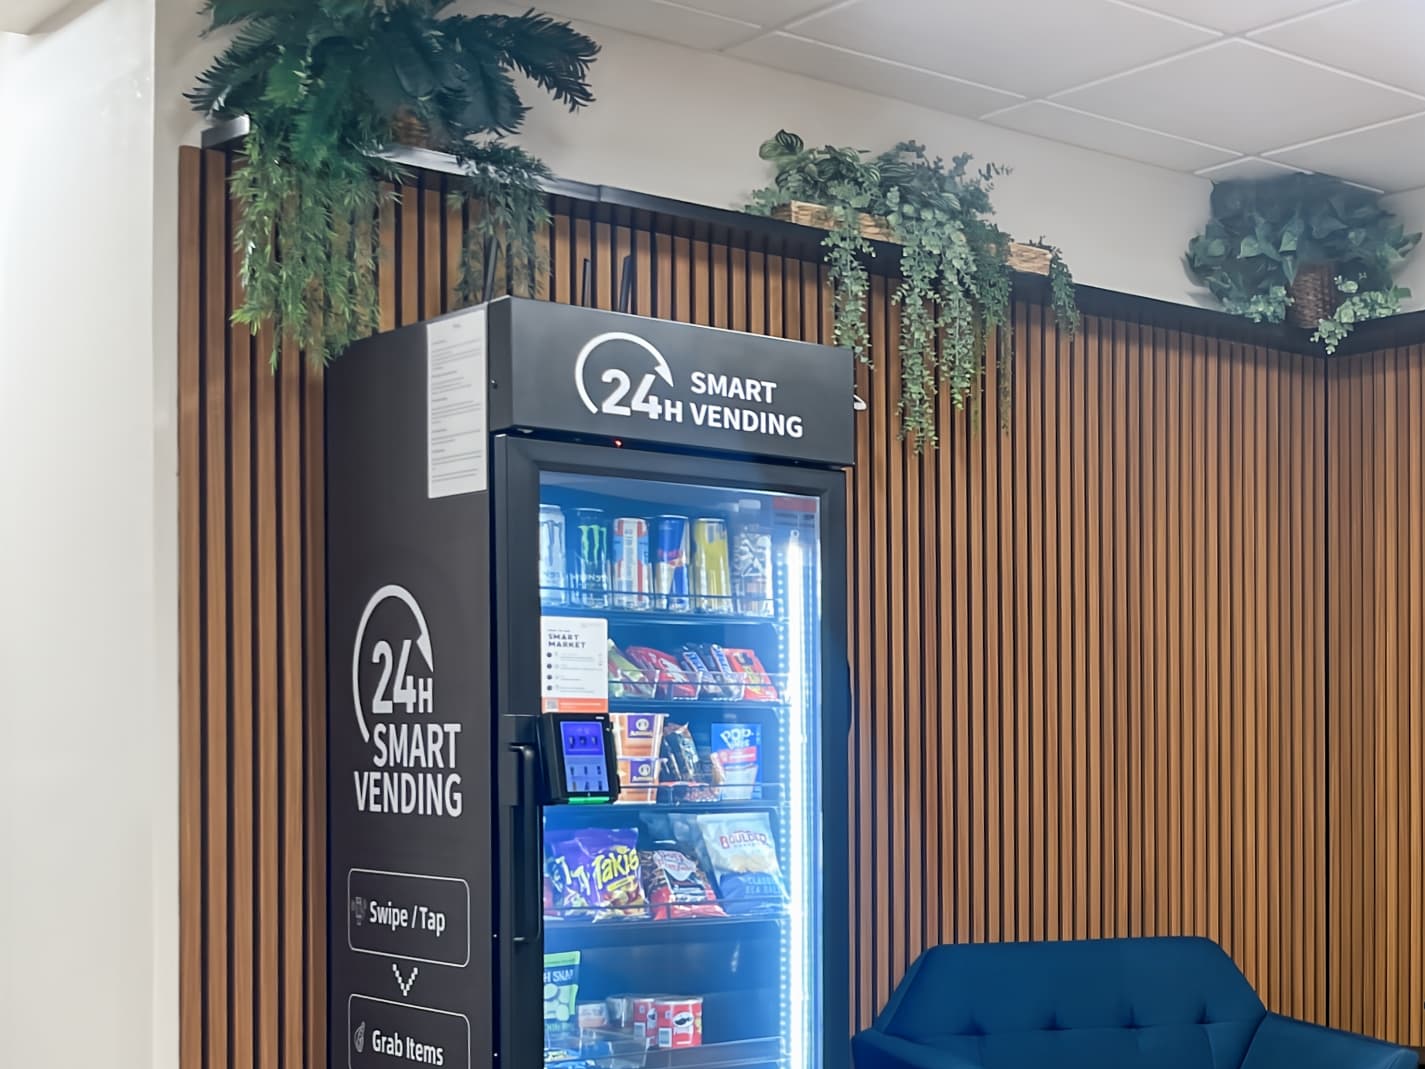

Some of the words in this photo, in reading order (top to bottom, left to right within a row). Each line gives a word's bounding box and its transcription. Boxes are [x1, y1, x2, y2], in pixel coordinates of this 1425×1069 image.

[601, 369, 684, 424] 24H
[690, 370, 777, 403] SMART
[689, 402, 804, 438] VENDING
[548, 633, 579, 641] SMART
[372, 640, 434, 714] 24H
[373, 723, 462, 769] SMART
[354, 771, 462, 818] VENDING
[592, 850, 639, 889] Takis
[370, 900, 409, 931] Swipe
[418, 906, 446, 937] Tap
[372, 1029, 403, 1057] Grab
[406, 1036, 444, 1066] Items
